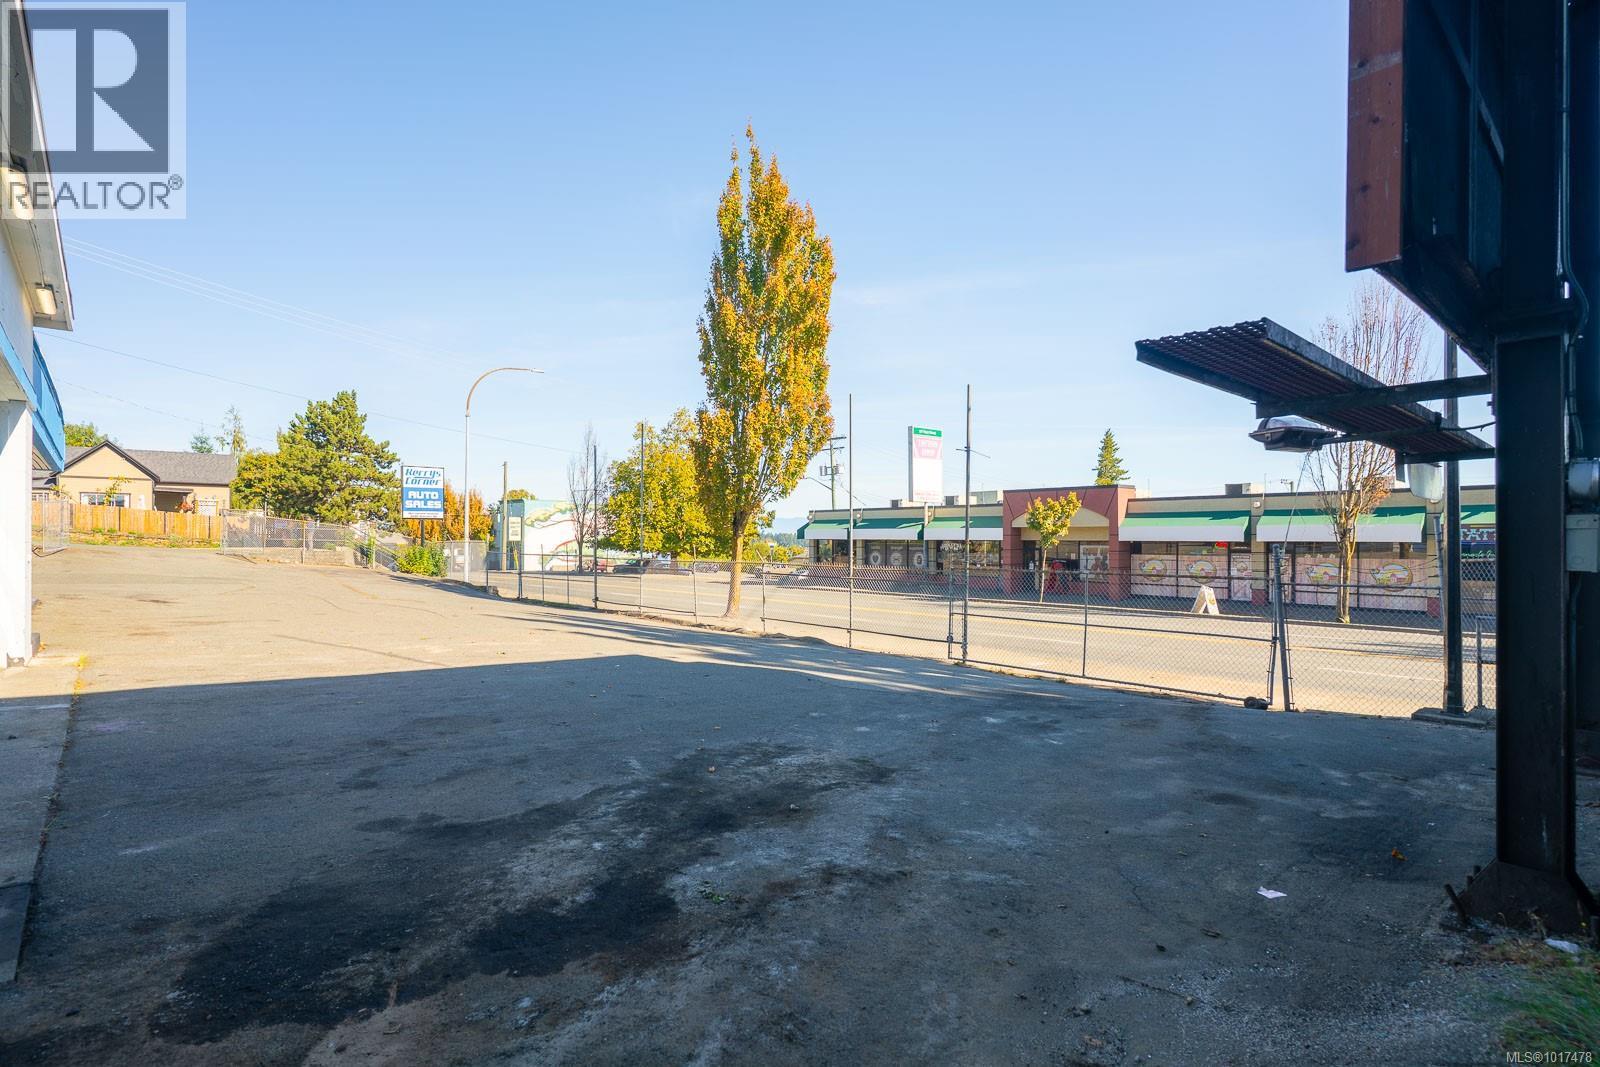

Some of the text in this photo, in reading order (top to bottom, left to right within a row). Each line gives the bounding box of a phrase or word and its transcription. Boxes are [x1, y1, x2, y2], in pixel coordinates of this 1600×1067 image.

[405, 477, 440, 485] Corner
[408, 491, 438, 499] AUTO
[405, 500, 441, 508] SALES
